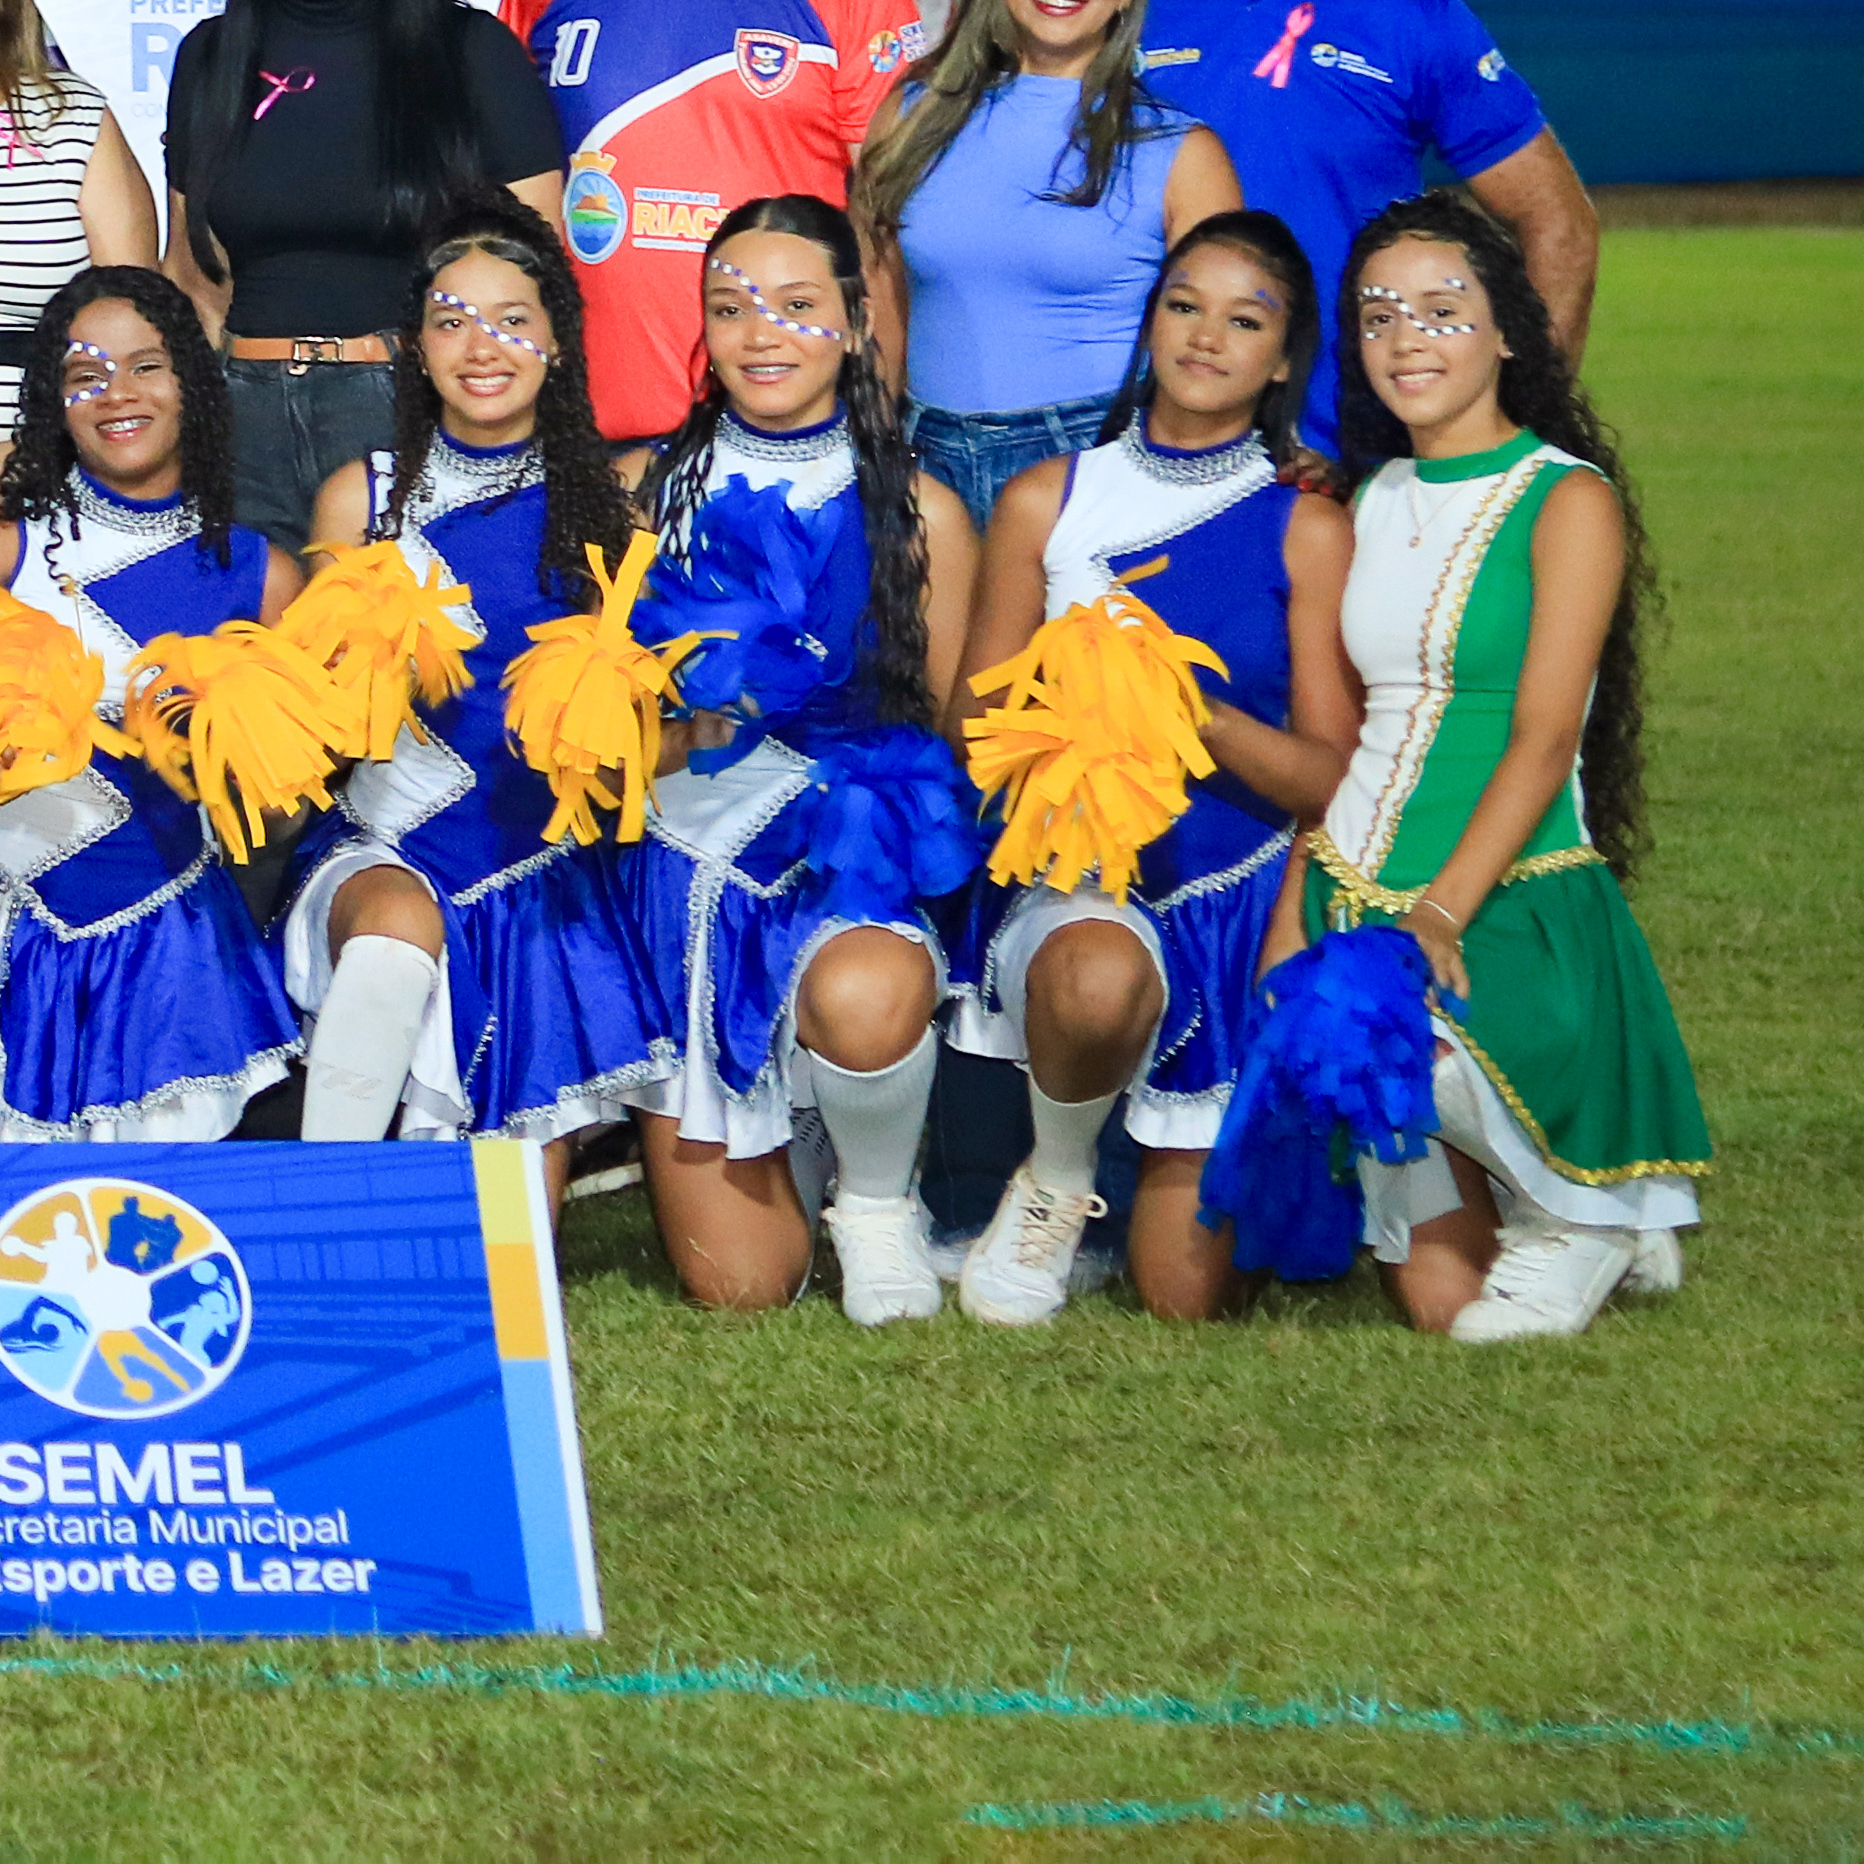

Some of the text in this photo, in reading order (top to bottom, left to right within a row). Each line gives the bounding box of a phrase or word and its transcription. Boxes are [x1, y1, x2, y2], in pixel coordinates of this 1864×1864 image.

[549, 18, 602, 88] 10
[148, 1508, 349, 1552] Municipal
[186, 1561, 221, 1593] e
[227, 1551, 377, 1593] Lazer
